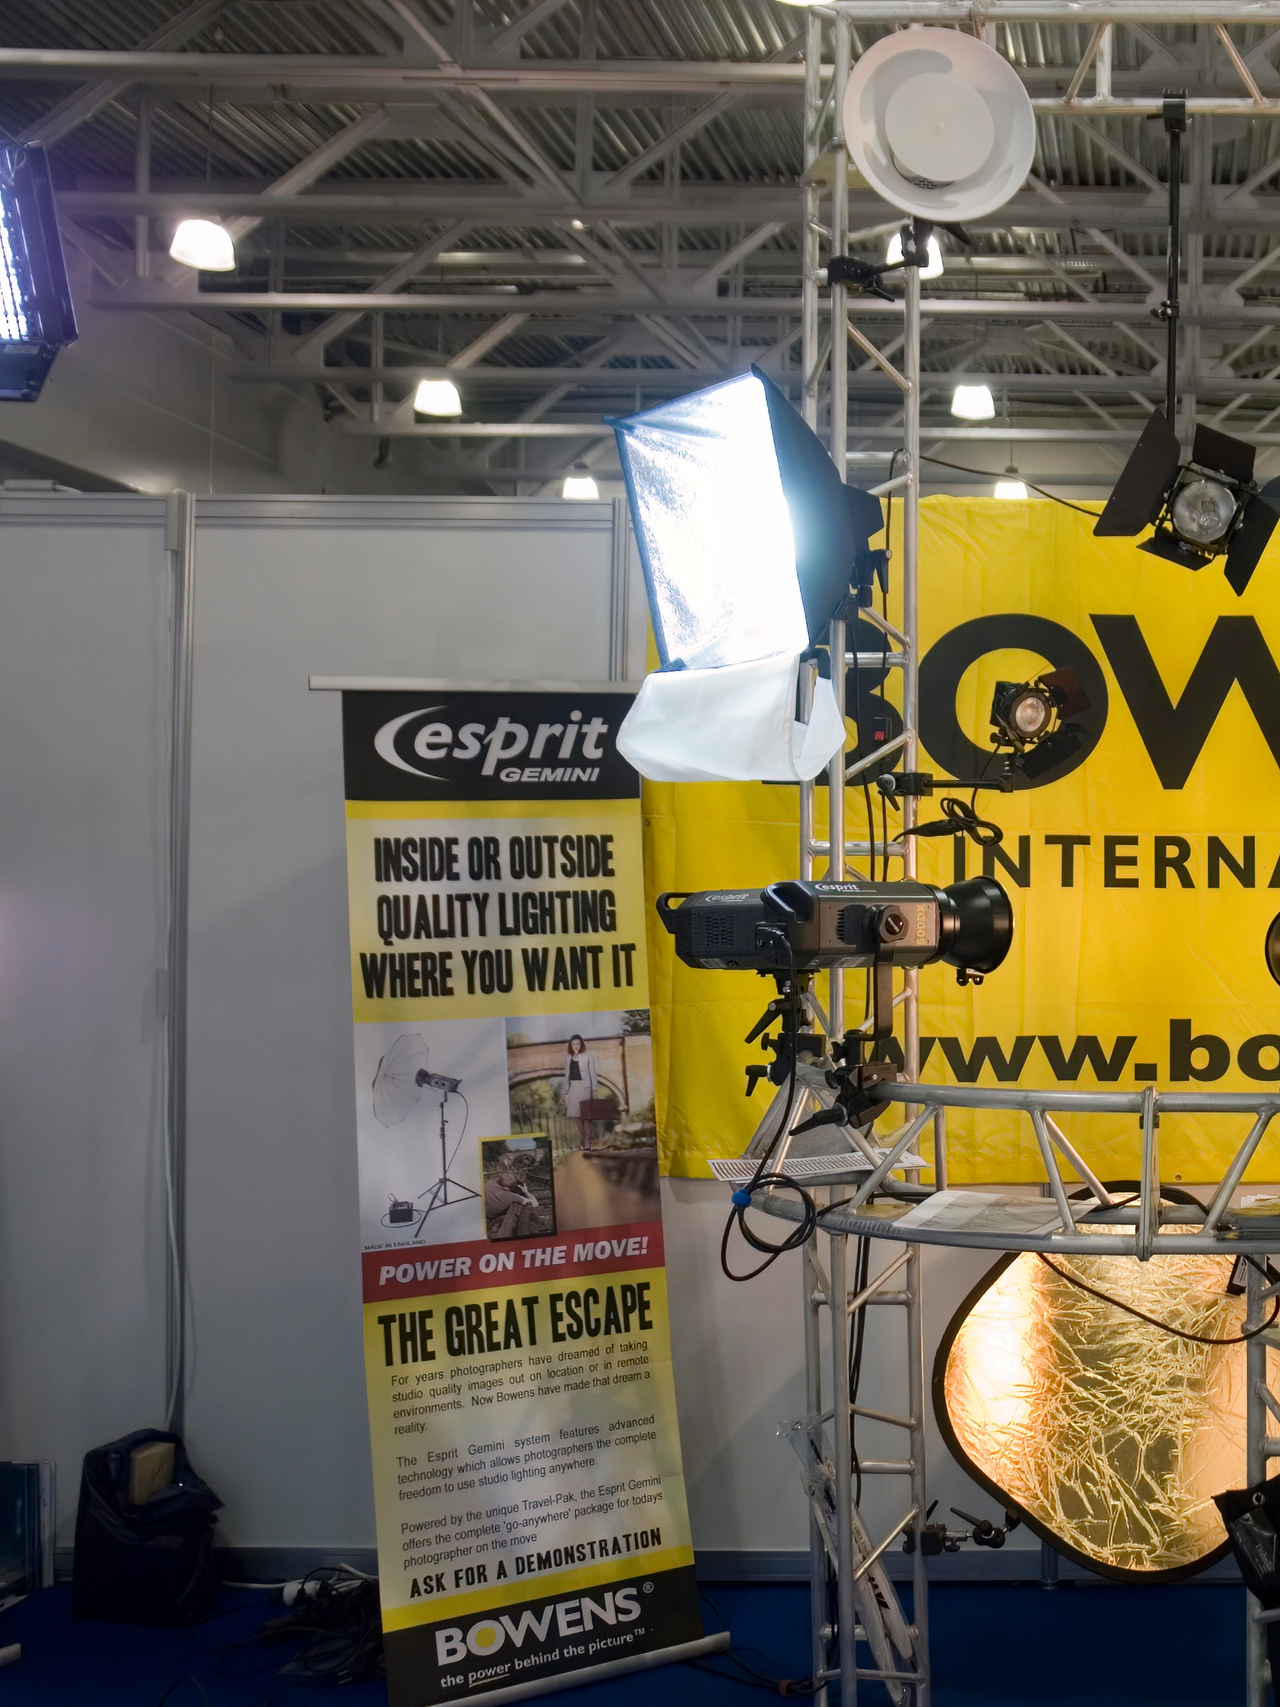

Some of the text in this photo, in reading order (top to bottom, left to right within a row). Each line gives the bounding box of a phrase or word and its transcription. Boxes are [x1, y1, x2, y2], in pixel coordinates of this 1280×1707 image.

[413, 710, 608, 776] esprit
[499, 767, 600, 783] GEMINI
[374, 834, 616, 882] INSIDE OR OUTSIDE
[377, 889, 617, 946] QUALITY LIGHTING
[360, 943, 637, 998] WHERE YOU WANT IT
[379, 1236, 649, 1285] POWER ON THE MOVE!
[393, 1239, 426, 1247] ENGLAND
[377, 1282, 653, 1367] THE GREAT ESCAPE
[391, 1340, 648, 1386] For years photographers have dreamed of taking
[392, 1355, 649, 1403] studio quality images out on location or in remote
[393, 1371, 650, 1419] environments. Now Bowens have made that dream a
[394, 1421, 428, 1435] reality.
[396, 1414, 655, 1468] The Esprit Gemini system features advanced
[398, 1430, 657, 1485] technology which allows photographers the complete
[398, 1457, 598, 1501] freedom to use studio lighting anywhere.
[401, 1475, 662, 1534] Powered by the unique Travel-Pak, the Esprit Gemini
[402, 1491, 663, 1552] offers the complete 'go-anywhere' package for todays
[403, 1533, 537, 1571] photographer on the move
[410, 1527, 662, 1598] ASK FOR A DEMONSTRATION
[440, 1673, 465, 1688] the
[468, 1661, 511, 1685] power
[514, 1647, 560, 1670] behind
[563, 1643, 585, 1659] the
